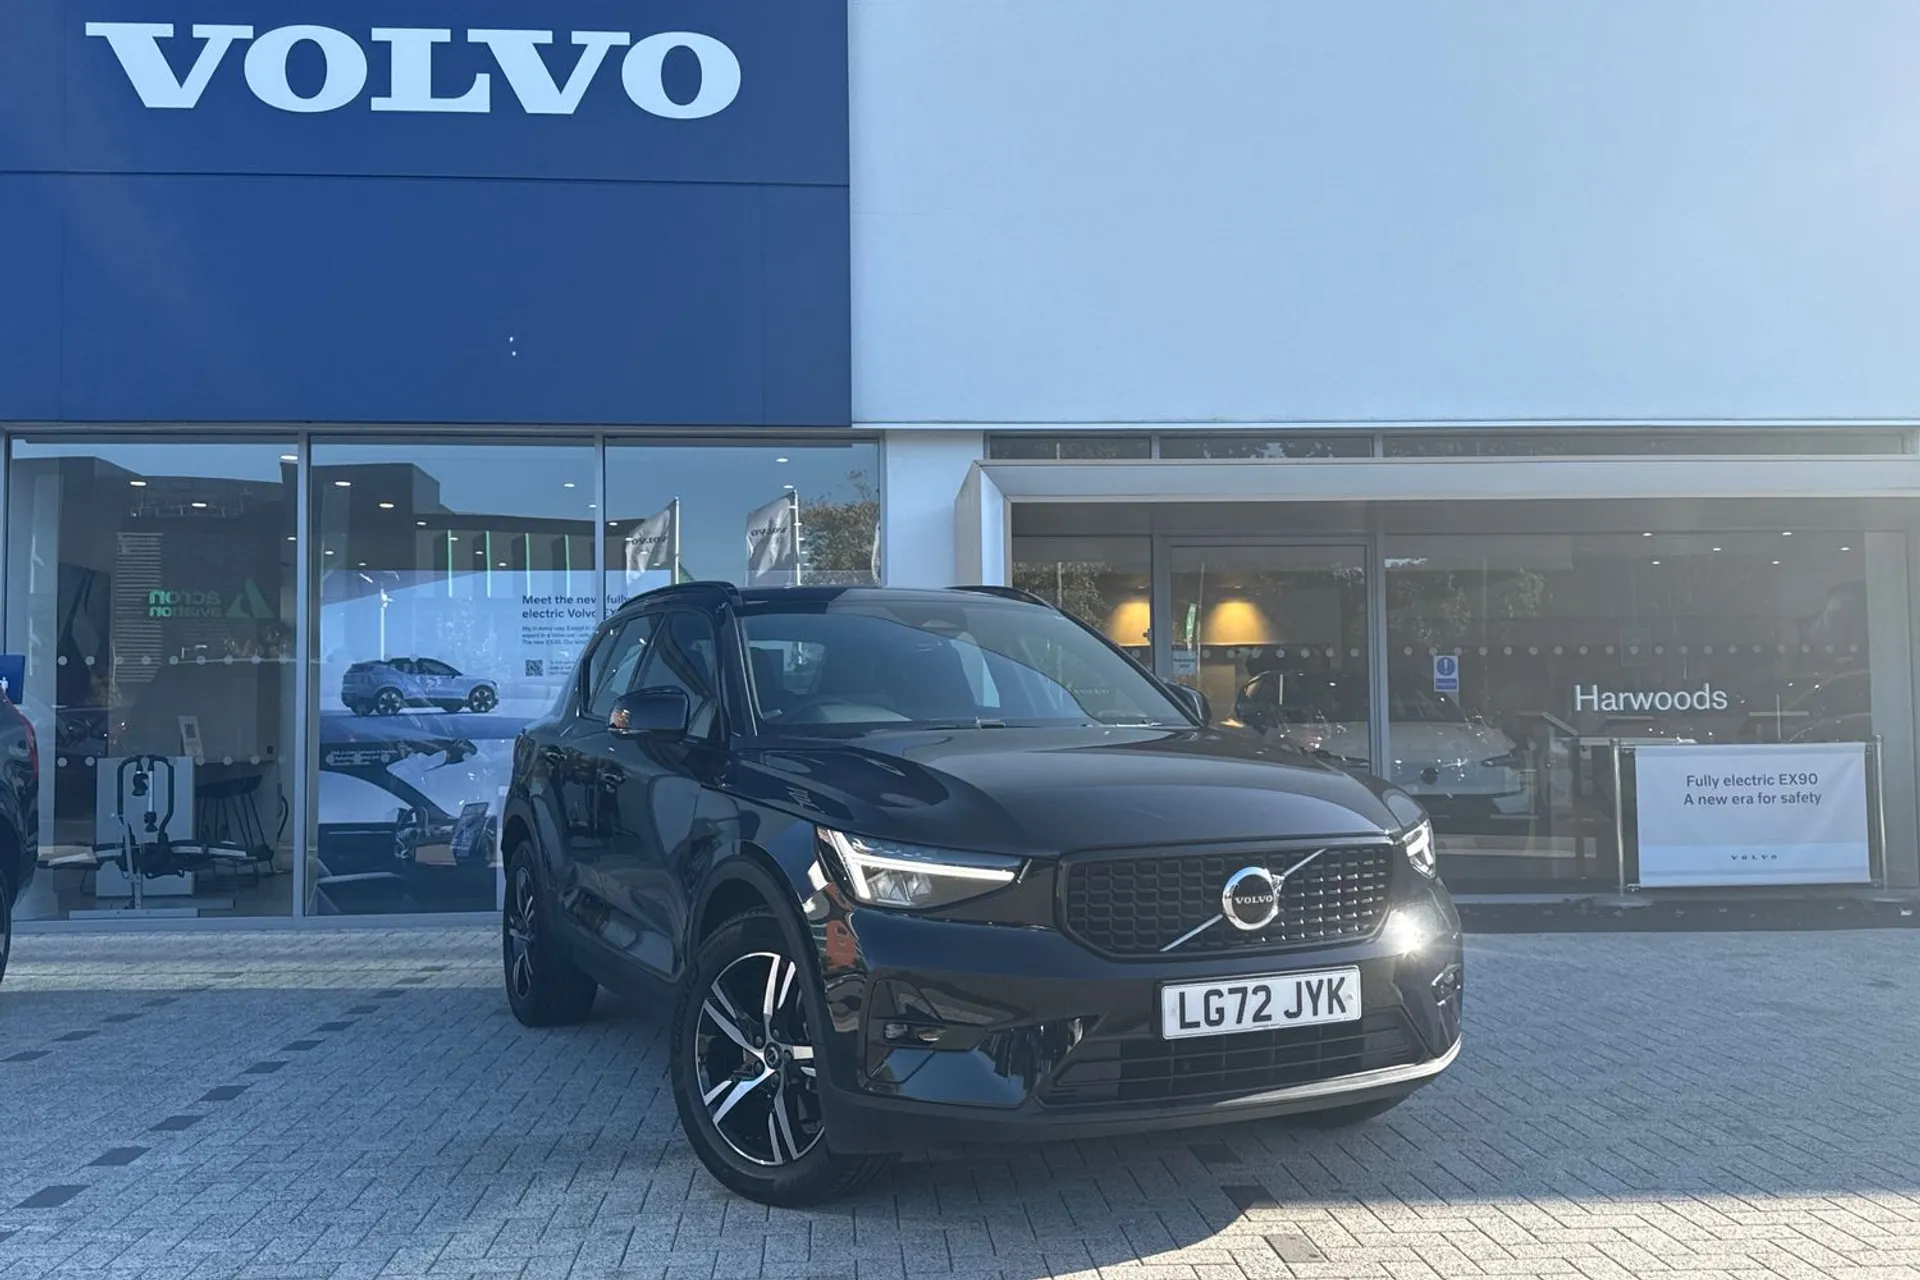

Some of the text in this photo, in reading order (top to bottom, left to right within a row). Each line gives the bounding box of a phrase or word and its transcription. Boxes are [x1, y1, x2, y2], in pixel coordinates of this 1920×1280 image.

[85, 22, 741, 119] VOLVO
[522, 595, 552, 605] Meet
[555, 595, 574, 605] the
[522, 608, 565, 619] electric
[1574, 683, 1728, 712] Harwoods
[1686, 772, 1818, 790] Fully electric EX90
[1684, 791, 1822, 806] A new era for safety
[1235, 894, 1274, 905] VOLVO
[1178, 976, 1347, 1030] LG72 JYK
